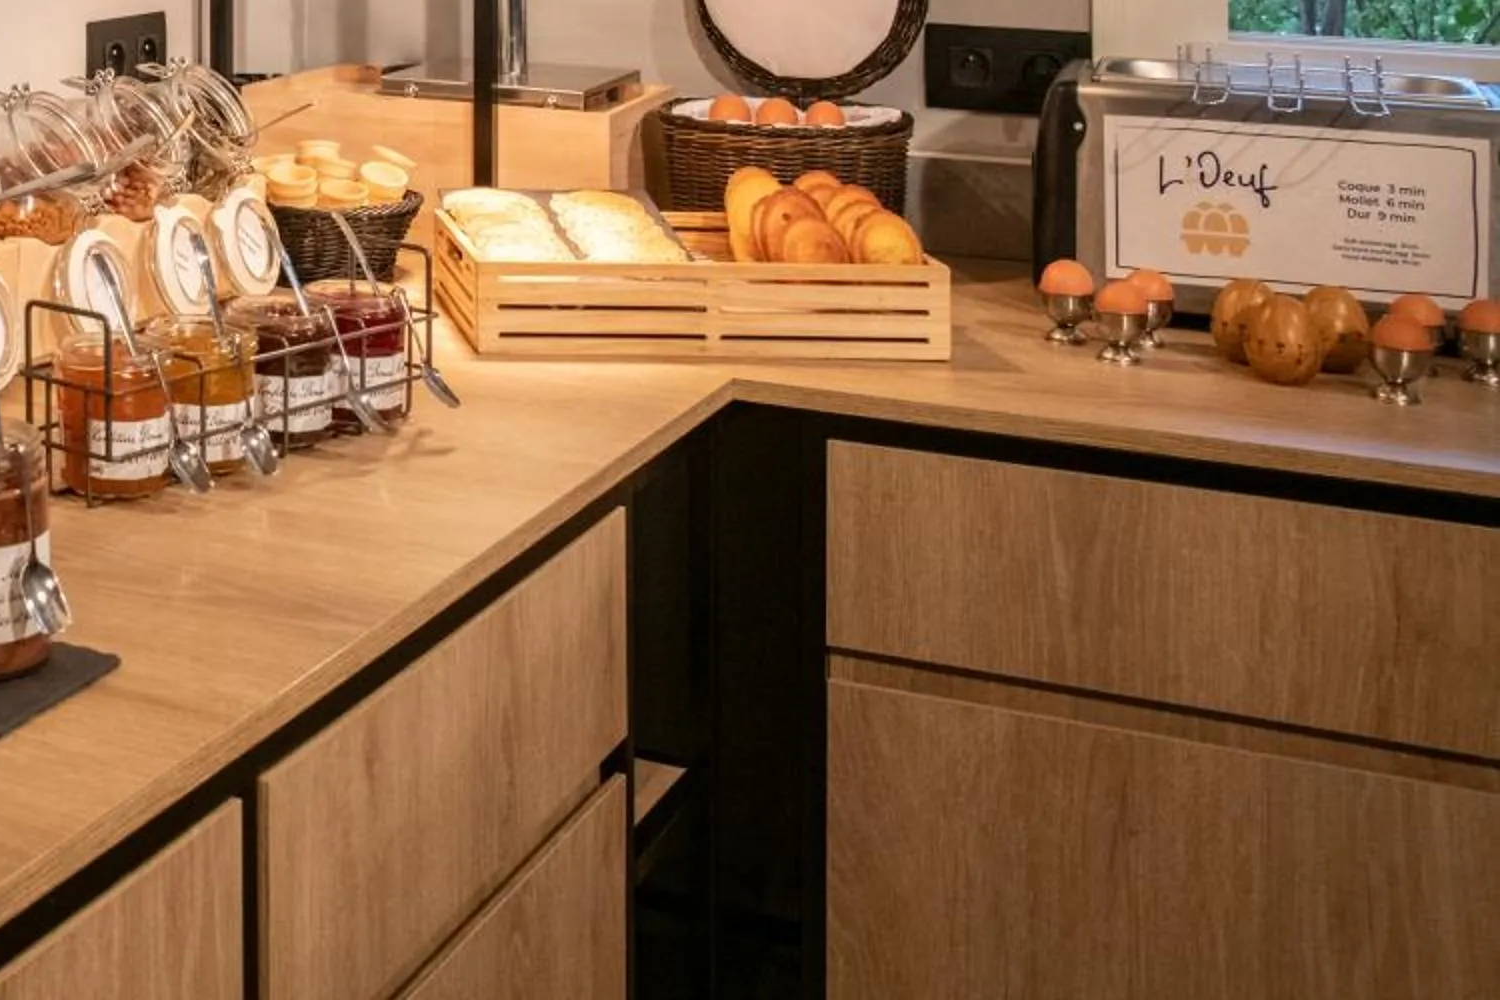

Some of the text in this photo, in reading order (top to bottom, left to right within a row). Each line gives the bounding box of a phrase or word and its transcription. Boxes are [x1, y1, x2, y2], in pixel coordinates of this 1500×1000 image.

[1337, 180, 1380, 195] Coque
[1399, 185, 1425, 196] min
[1398, 199, 1425, 210] min
[1347, 207, 1371, 220] Dur
[1389, 212, 1416, 223] min
